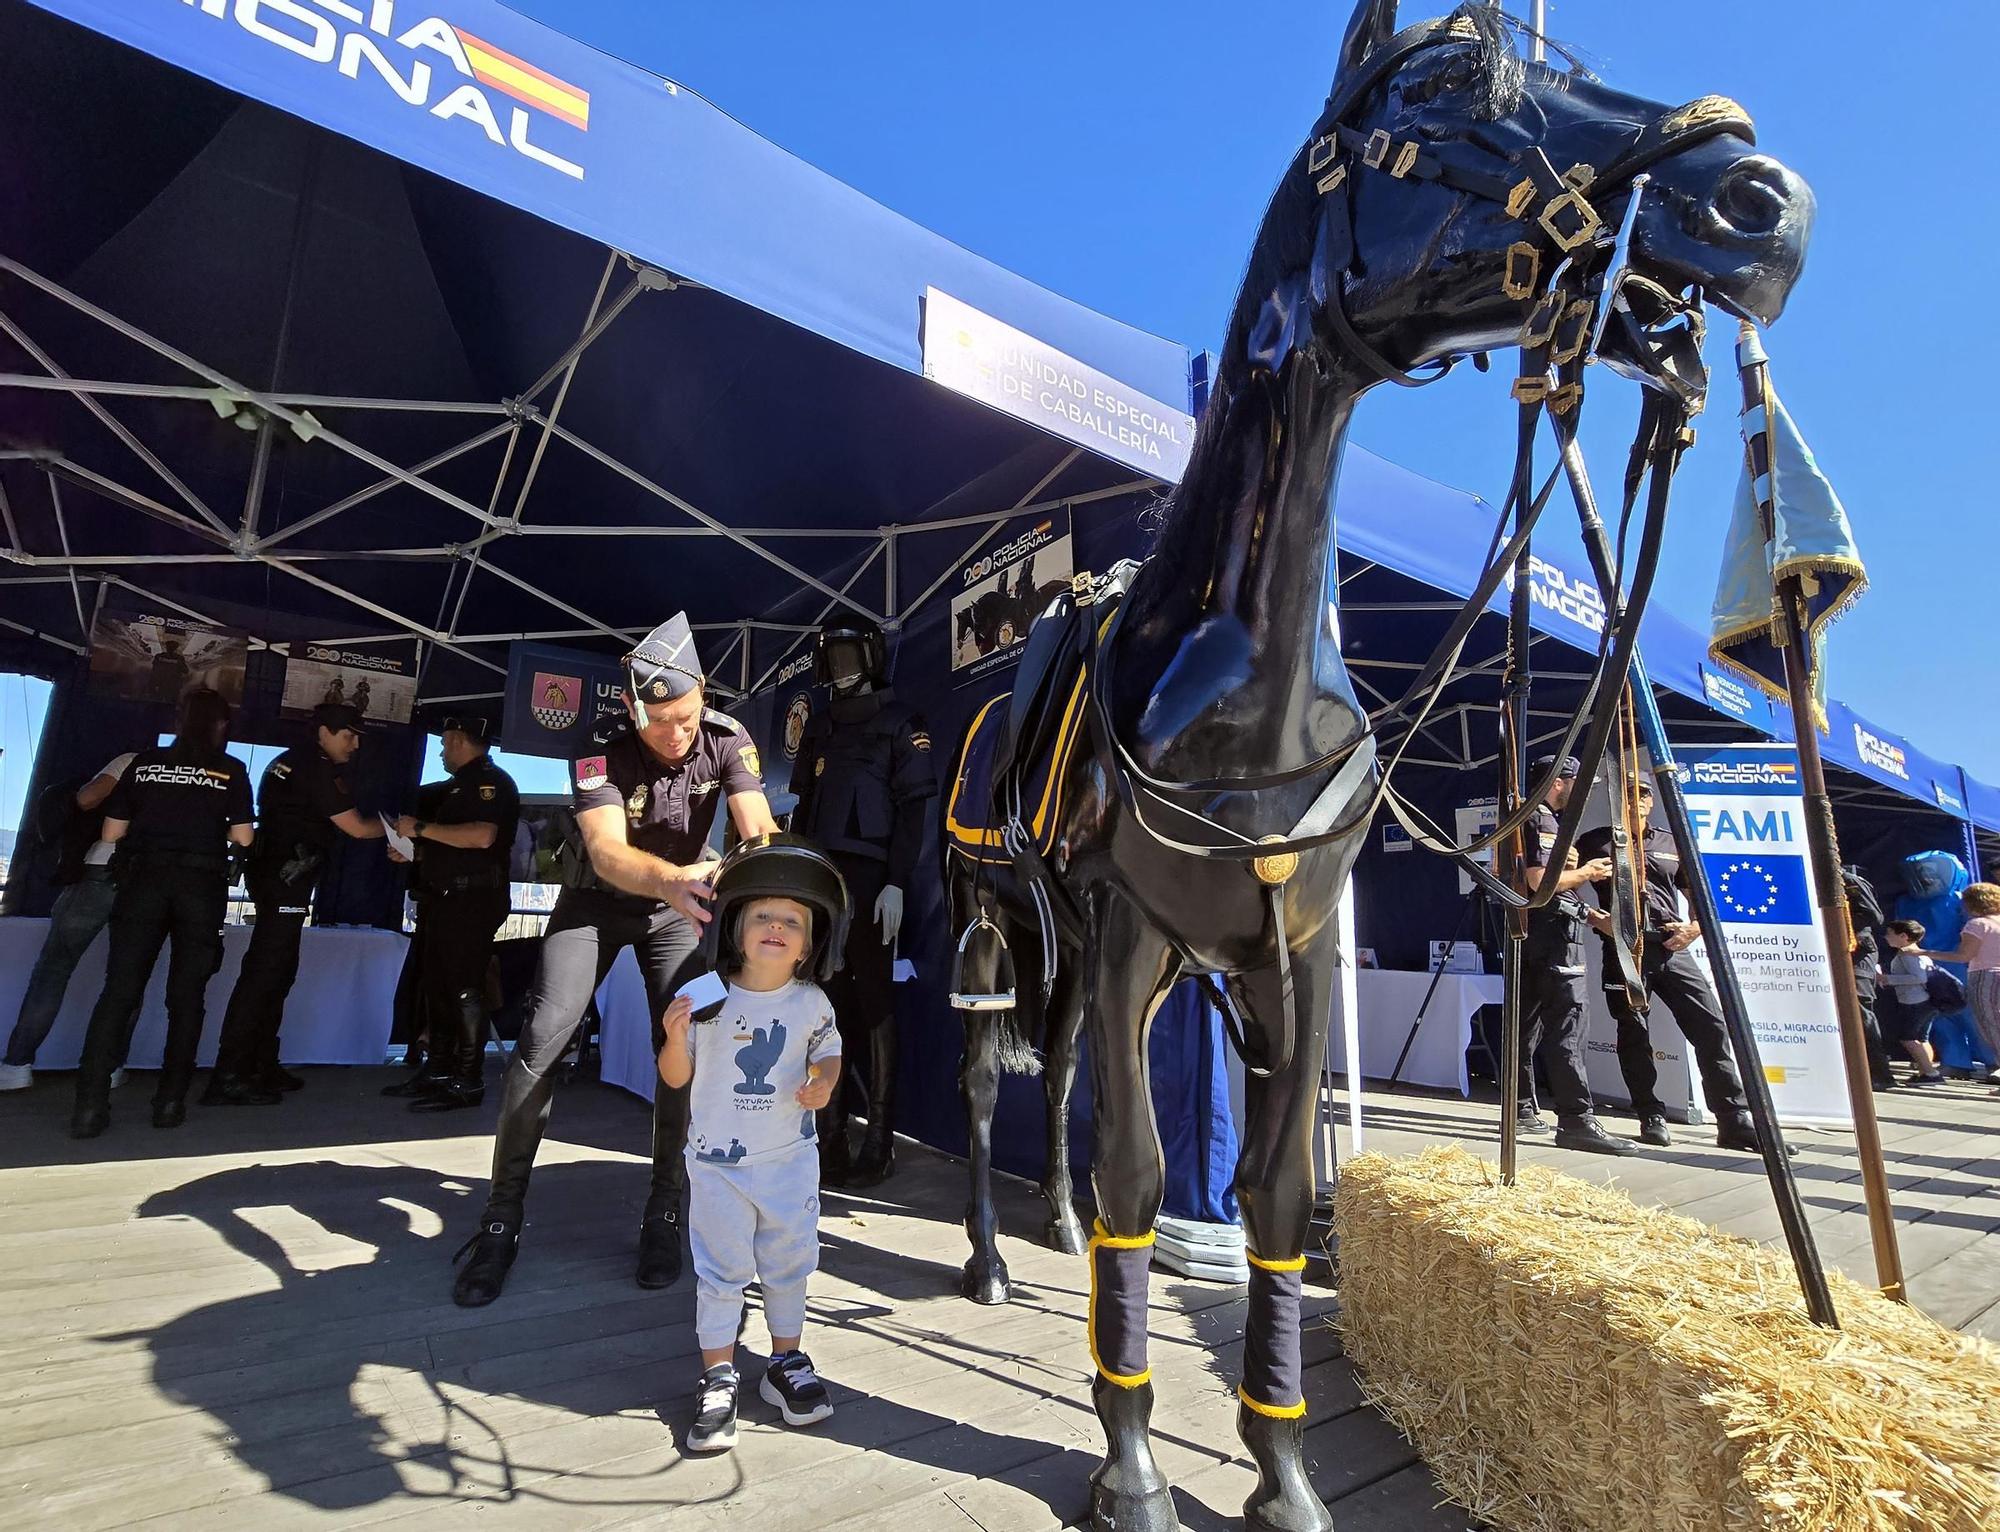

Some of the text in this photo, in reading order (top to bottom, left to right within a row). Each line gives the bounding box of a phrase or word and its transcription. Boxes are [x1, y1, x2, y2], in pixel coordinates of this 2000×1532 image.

[1001, 350, 1181, 444] UNIDAD ESPECIAL
[1003, 376, 1161, 459] DE CABALLERÍA
[993, 528, 1039, 560] POLICIA
[993, 532, 1053, 570] NACIONAL
[342, 651, 391, 665] POLICIA
[341, 659, 402, 672] NACIONAL
[135, 765, 208, 776] POLICIA
[1693, 763, 1774, 774] POLICIA
[135, 774, 228, 790] NACIONAL
[1695, 774, 1797, 784] NACIONAL
[1687, 809, 1793, 842] FAMI
[1723, 934, 1799, 948] o-funded by
[1696, 948, 1708, 958] th
[1785, 951, 1826, 962] Union
[1760, 965, 1820, 978] Migration
[1784, 1023, 1841, 1033] MIGRACIÓN
